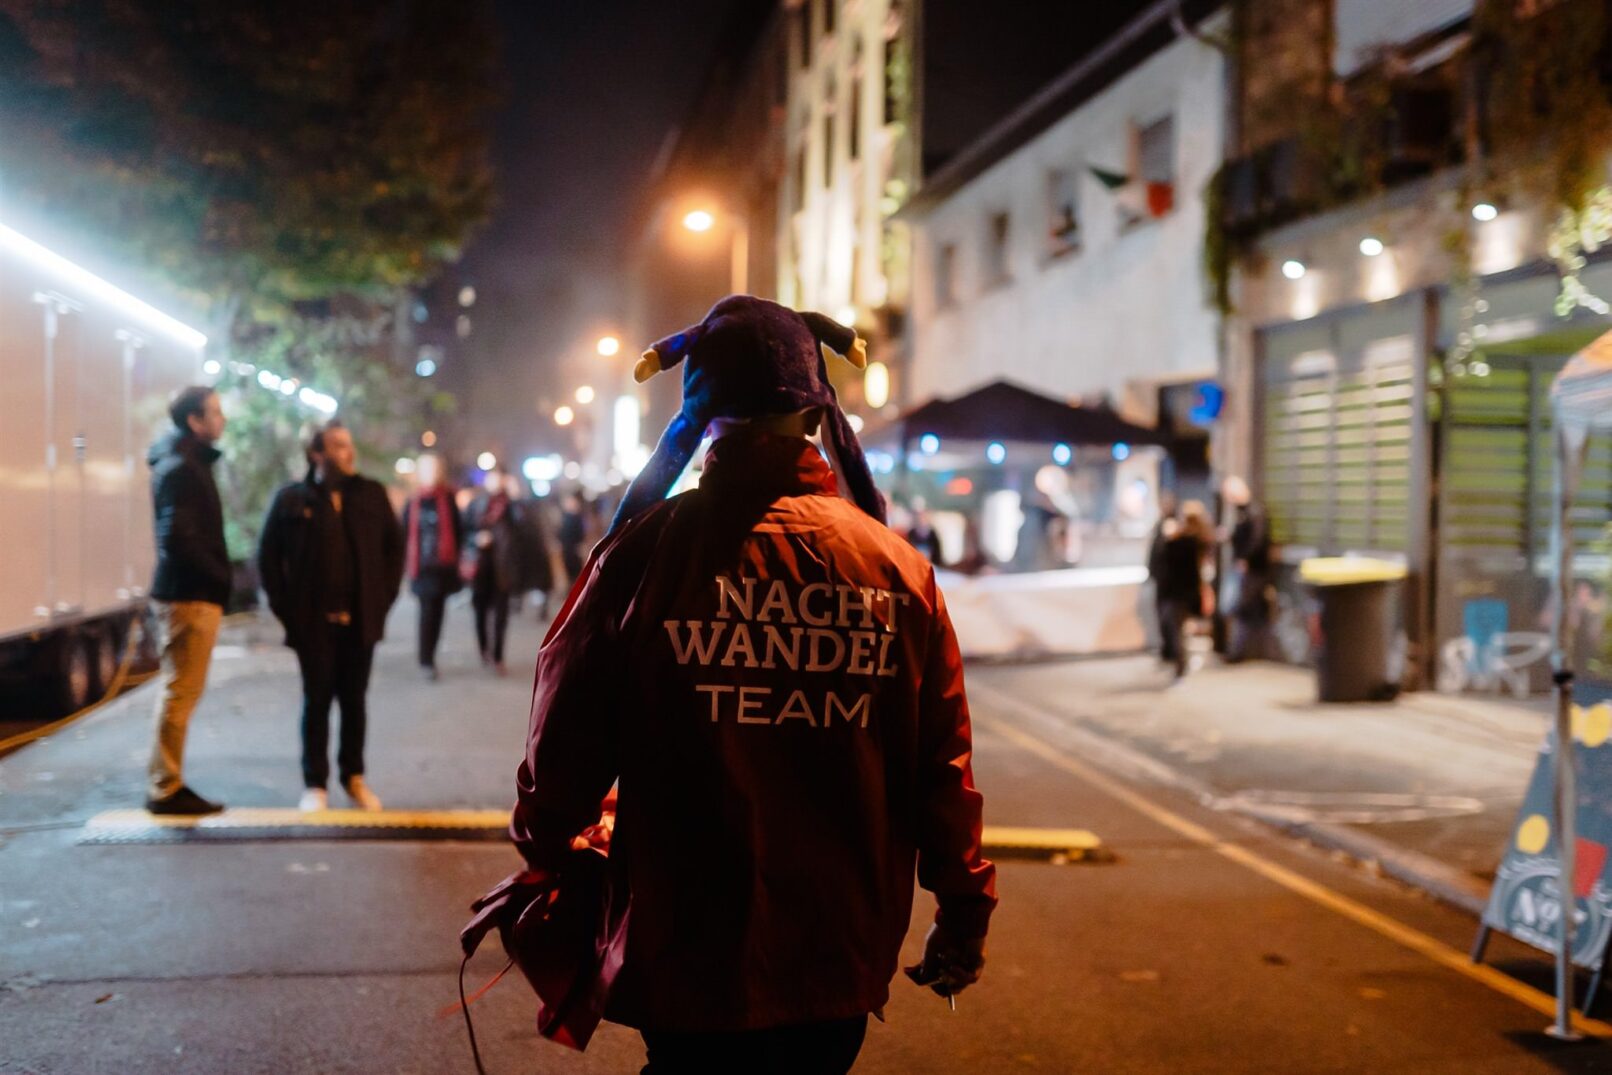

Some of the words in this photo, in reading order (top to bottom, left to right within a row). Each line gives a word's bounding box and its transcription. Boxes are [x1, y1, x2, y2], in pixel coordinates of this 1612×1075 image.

[715, 575, 910, 632] NACHT
[664, 620, 898, 676] WANDEL
[695, 685, 872, 728] TEAM
